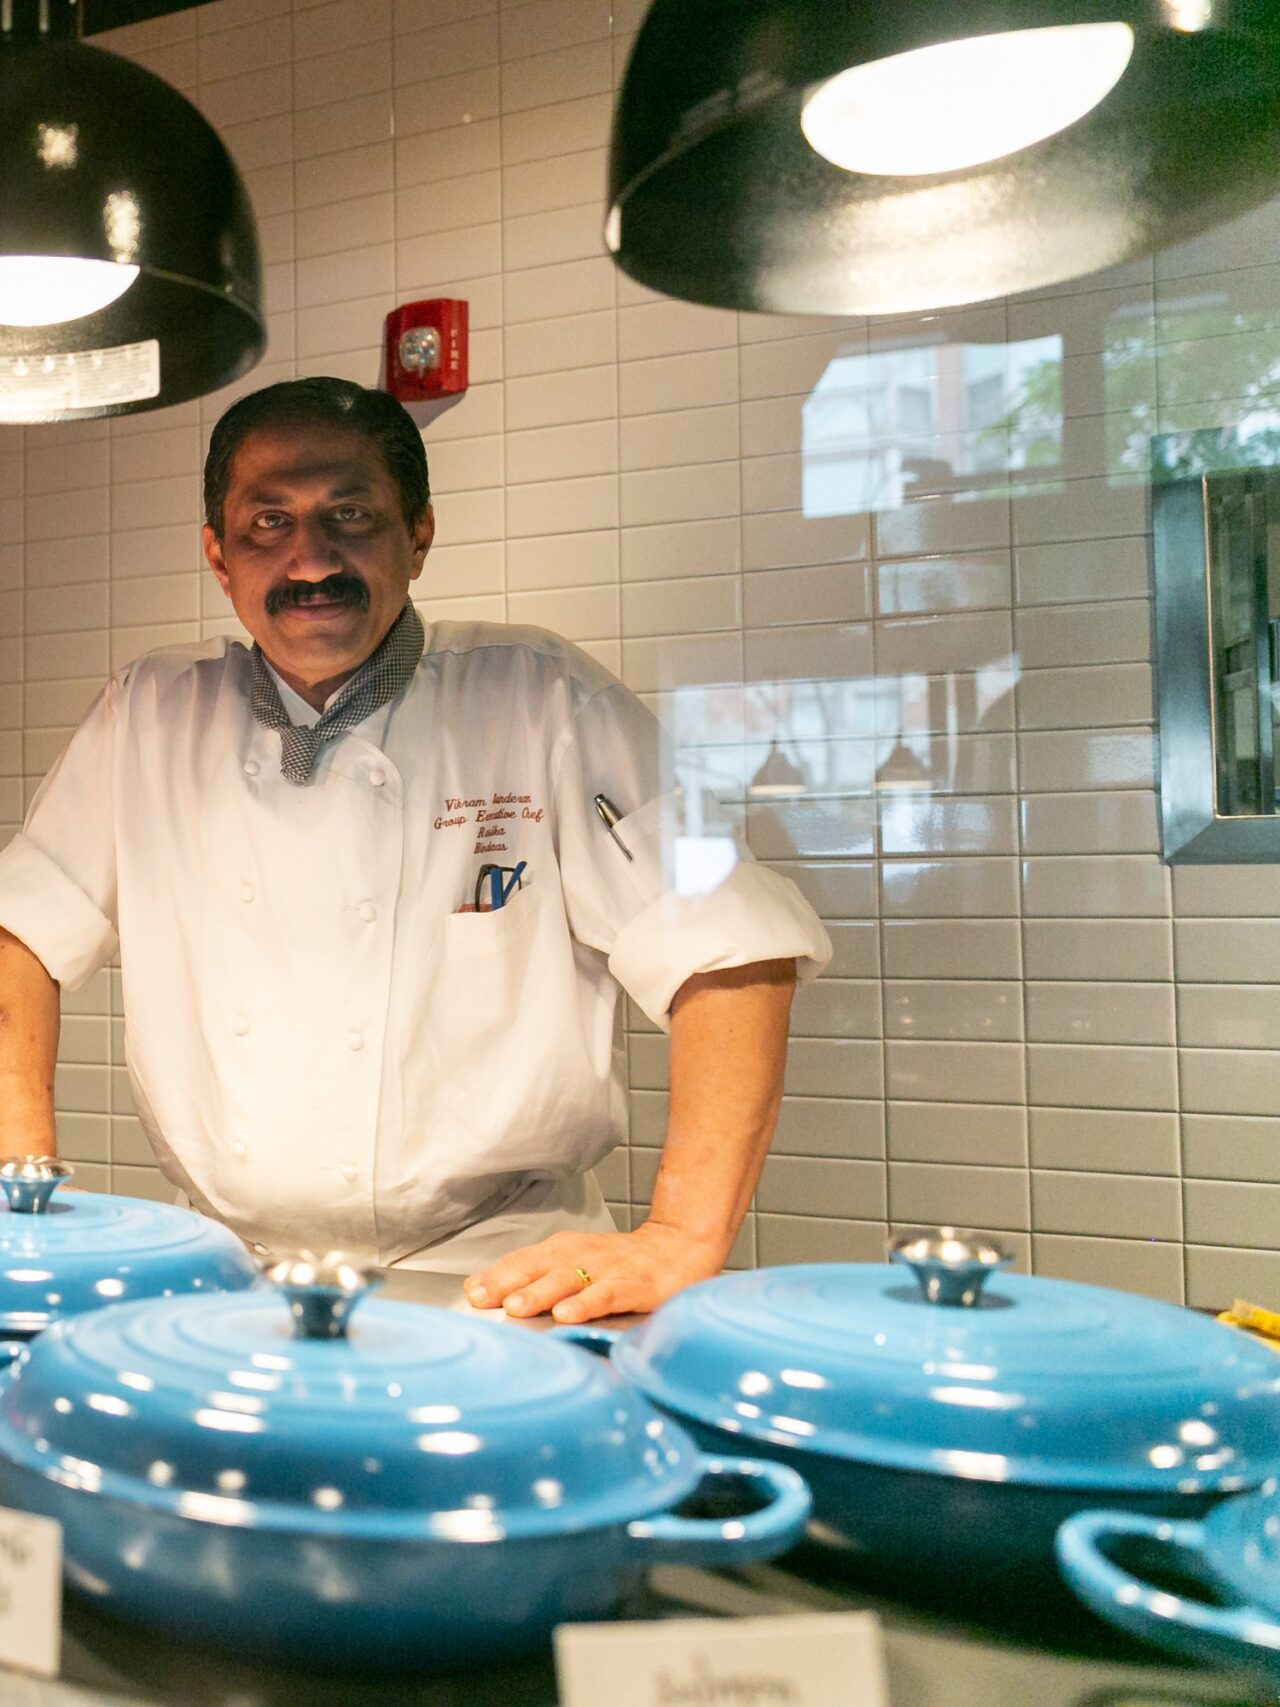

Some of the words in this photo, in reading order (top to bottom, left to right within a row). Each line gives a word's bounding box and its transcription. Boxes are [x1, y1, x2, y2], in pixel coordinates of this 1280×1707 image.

[450, 329, 459, 370] FIRE
[445, 798, 486, 811] Vikram
[434, 816, 467, 830] Group
